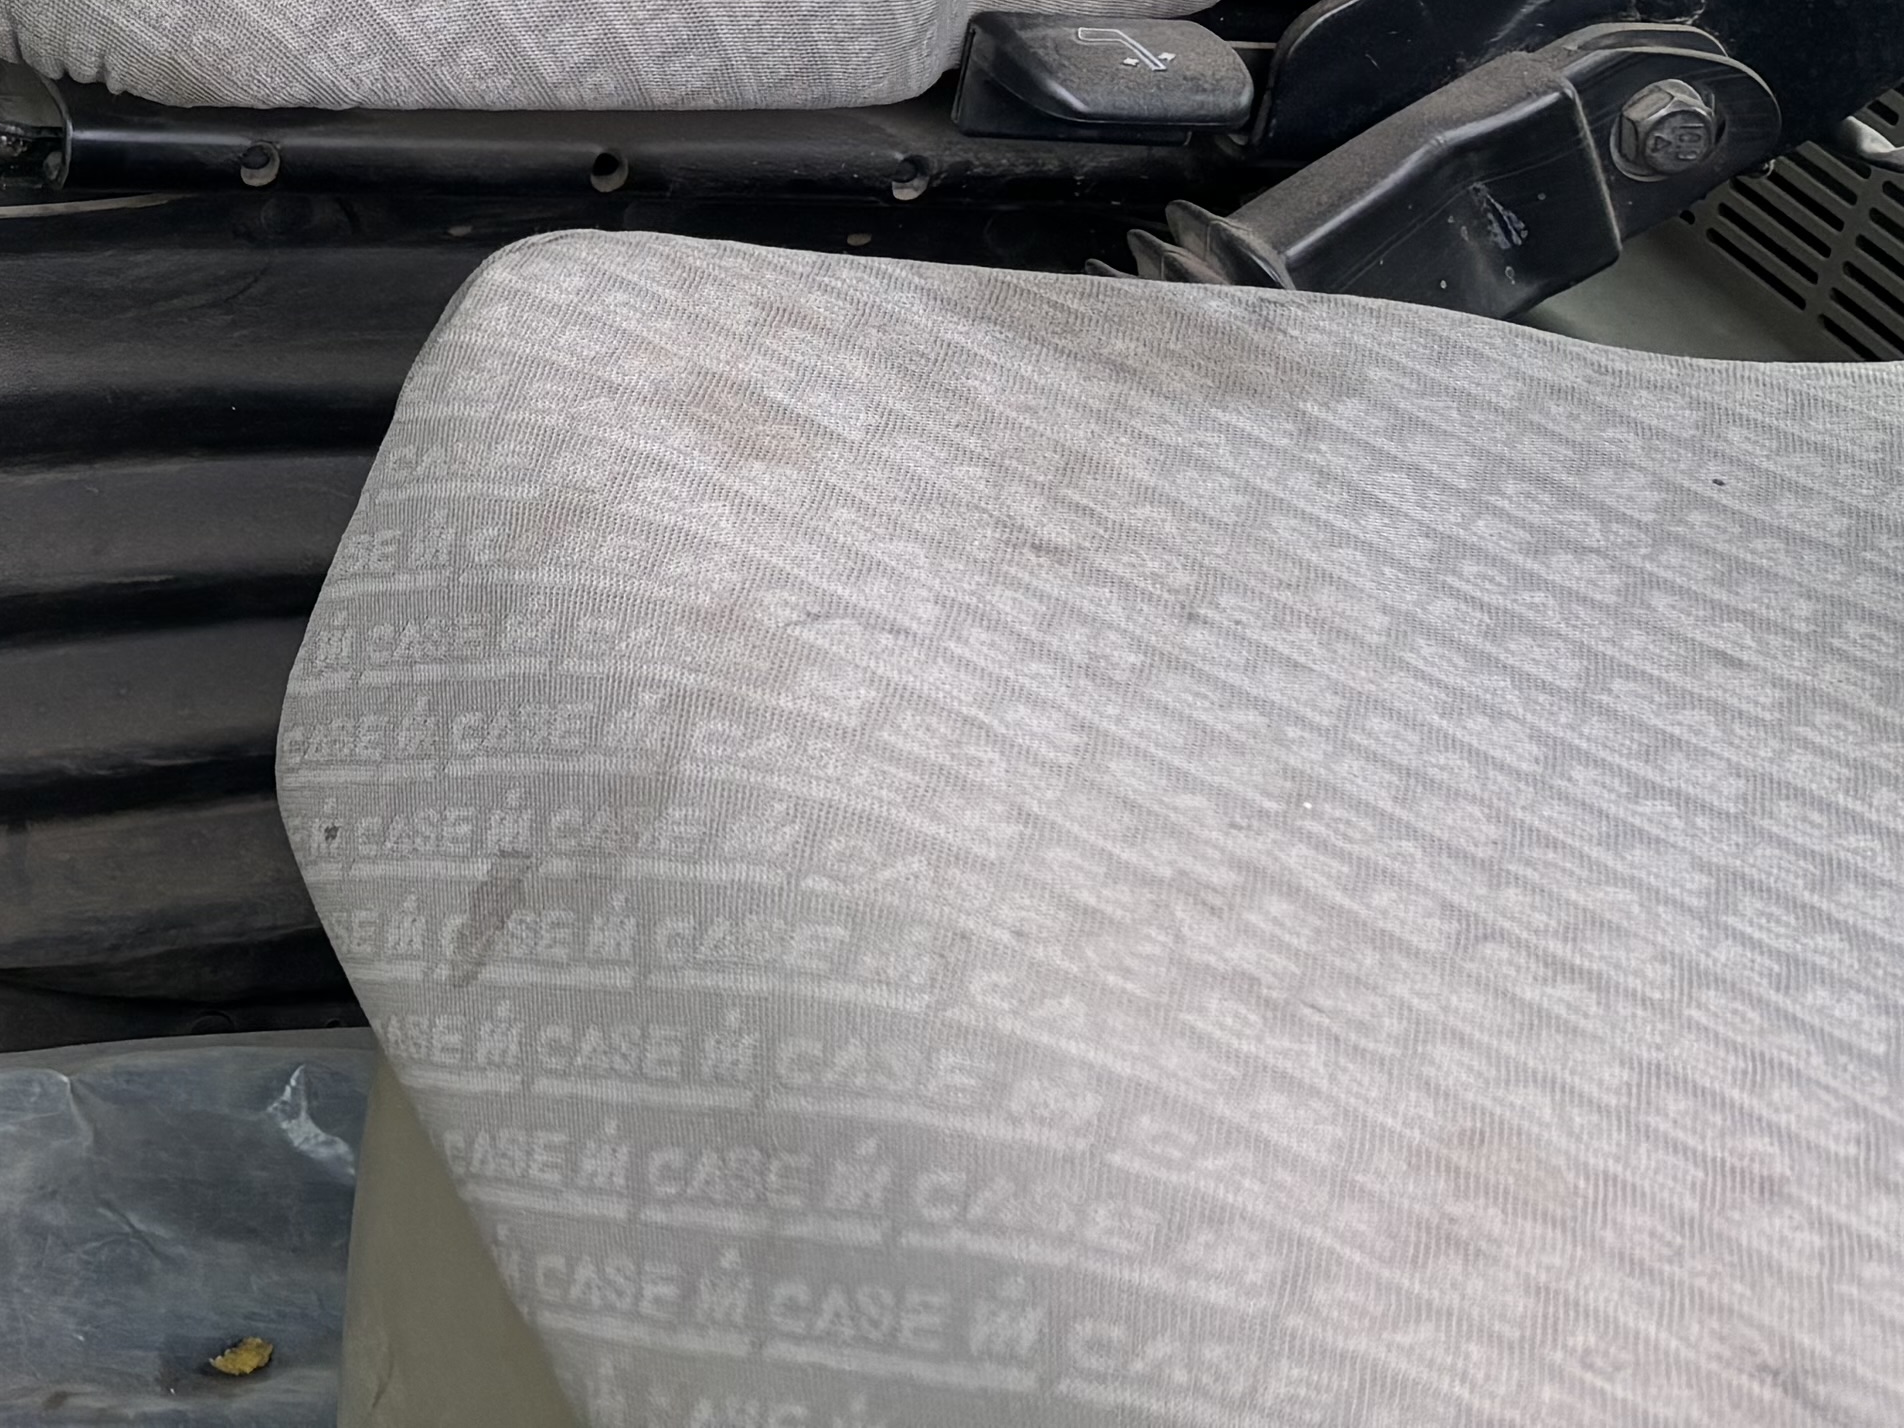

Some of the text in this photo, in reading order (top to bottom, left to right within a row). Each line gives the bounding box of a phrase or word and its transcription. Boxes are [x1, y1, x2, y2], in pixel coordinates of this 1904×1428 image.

[534, 1024, 692, 1081] CASE
[646, 1147, 816, 1208] CASE
[534, 1252, 682, 1319] CASE
[768, 1275, 949, 1348] CASE
